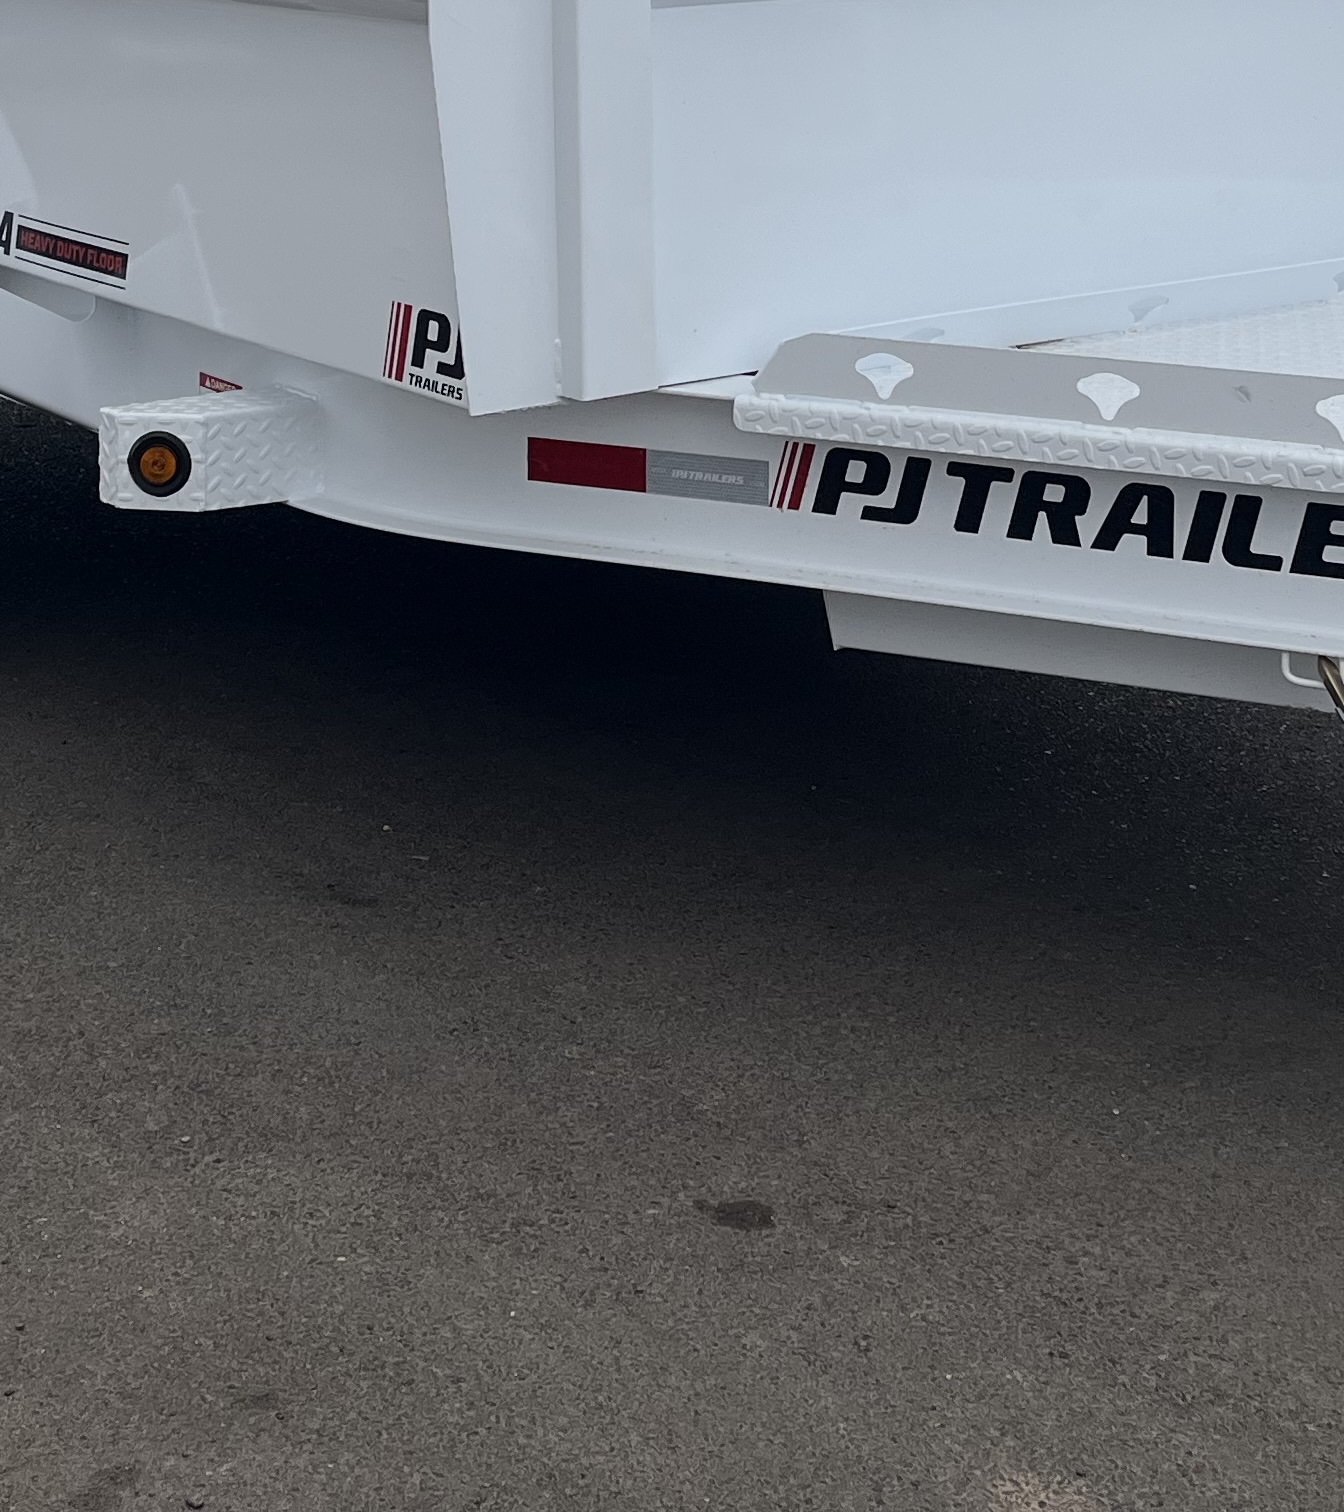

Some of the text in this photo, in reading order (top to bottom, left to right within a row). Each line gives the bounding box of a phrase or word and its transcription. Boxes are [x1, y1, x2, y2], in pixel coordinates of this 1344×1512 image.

[21, 230, 124, 275] HEAVY DUTY FLOOR
[408, 372, 464, 401] TRAILERS
[811, 446, 933, 525] PJ
